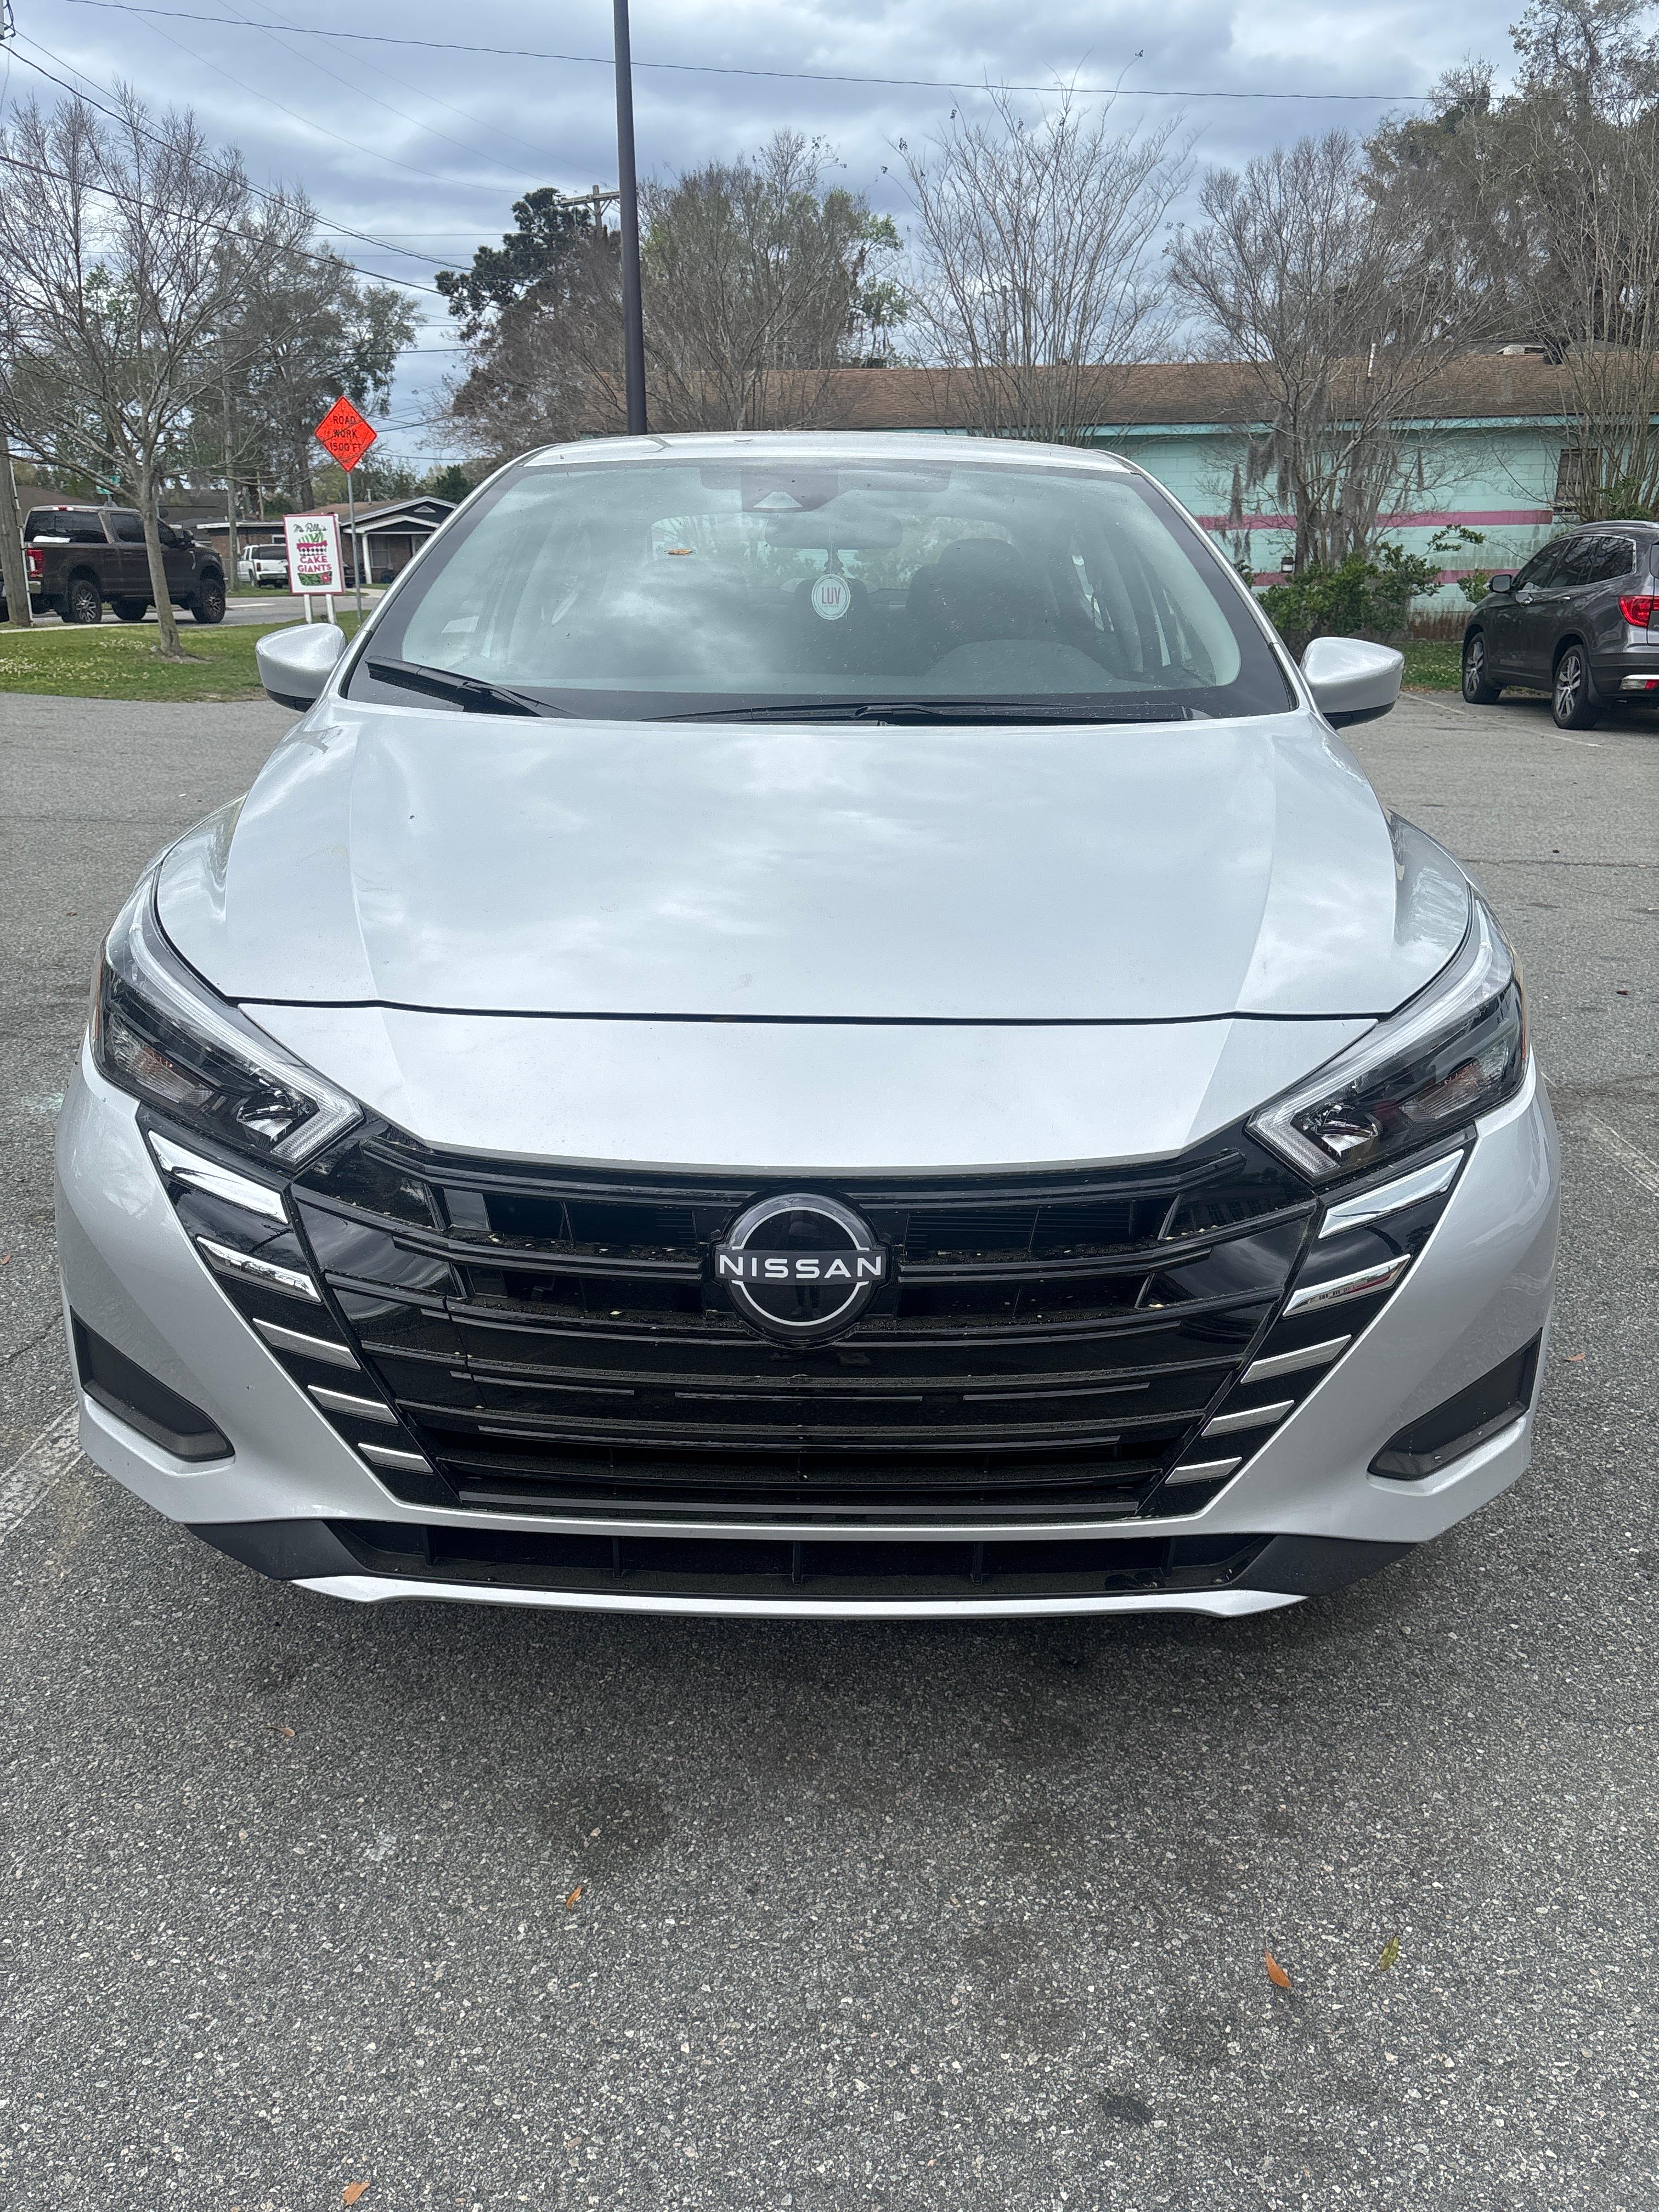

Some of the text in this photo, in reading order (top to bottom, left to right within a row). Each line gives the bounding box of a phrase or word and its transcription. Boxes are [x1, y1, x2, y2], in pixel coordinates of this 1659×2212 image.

[333, 415, 356, 425] ROAD
[334, 429, 358, 438] WORK
[330, 442, 363, 452] 1500 FT
[300, 555, 328, 564] CAKE
[297, 563, 332, 573] GIANTS
[821, 587, 841, 604] LUV
[719, 1254, 882, 1279] NISSAN
